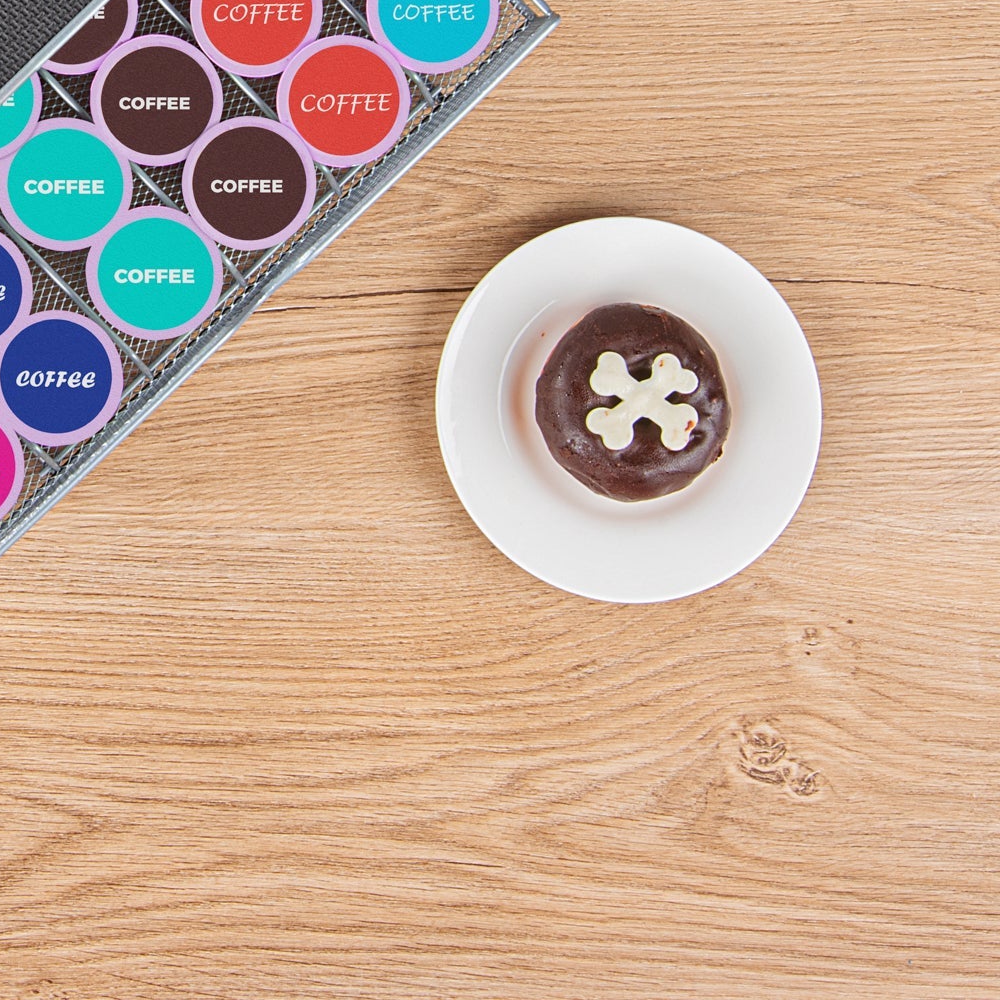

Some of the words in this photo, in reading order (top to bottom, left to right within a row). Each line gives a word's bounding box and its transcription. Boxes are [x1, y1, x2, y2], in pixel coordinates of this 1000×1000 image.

[213, 3, 305, 25] COFFEE
[392, 3, 475, 23] COFFEE
[118, 96, 191, 111] COFFEE
[300, 93, 392, 115] COFFEE
[23, 179, 105, 195] COFFEE
[210, 179, 284, 194] COFFEE
[113, 268, 195, 284] COFFEE
